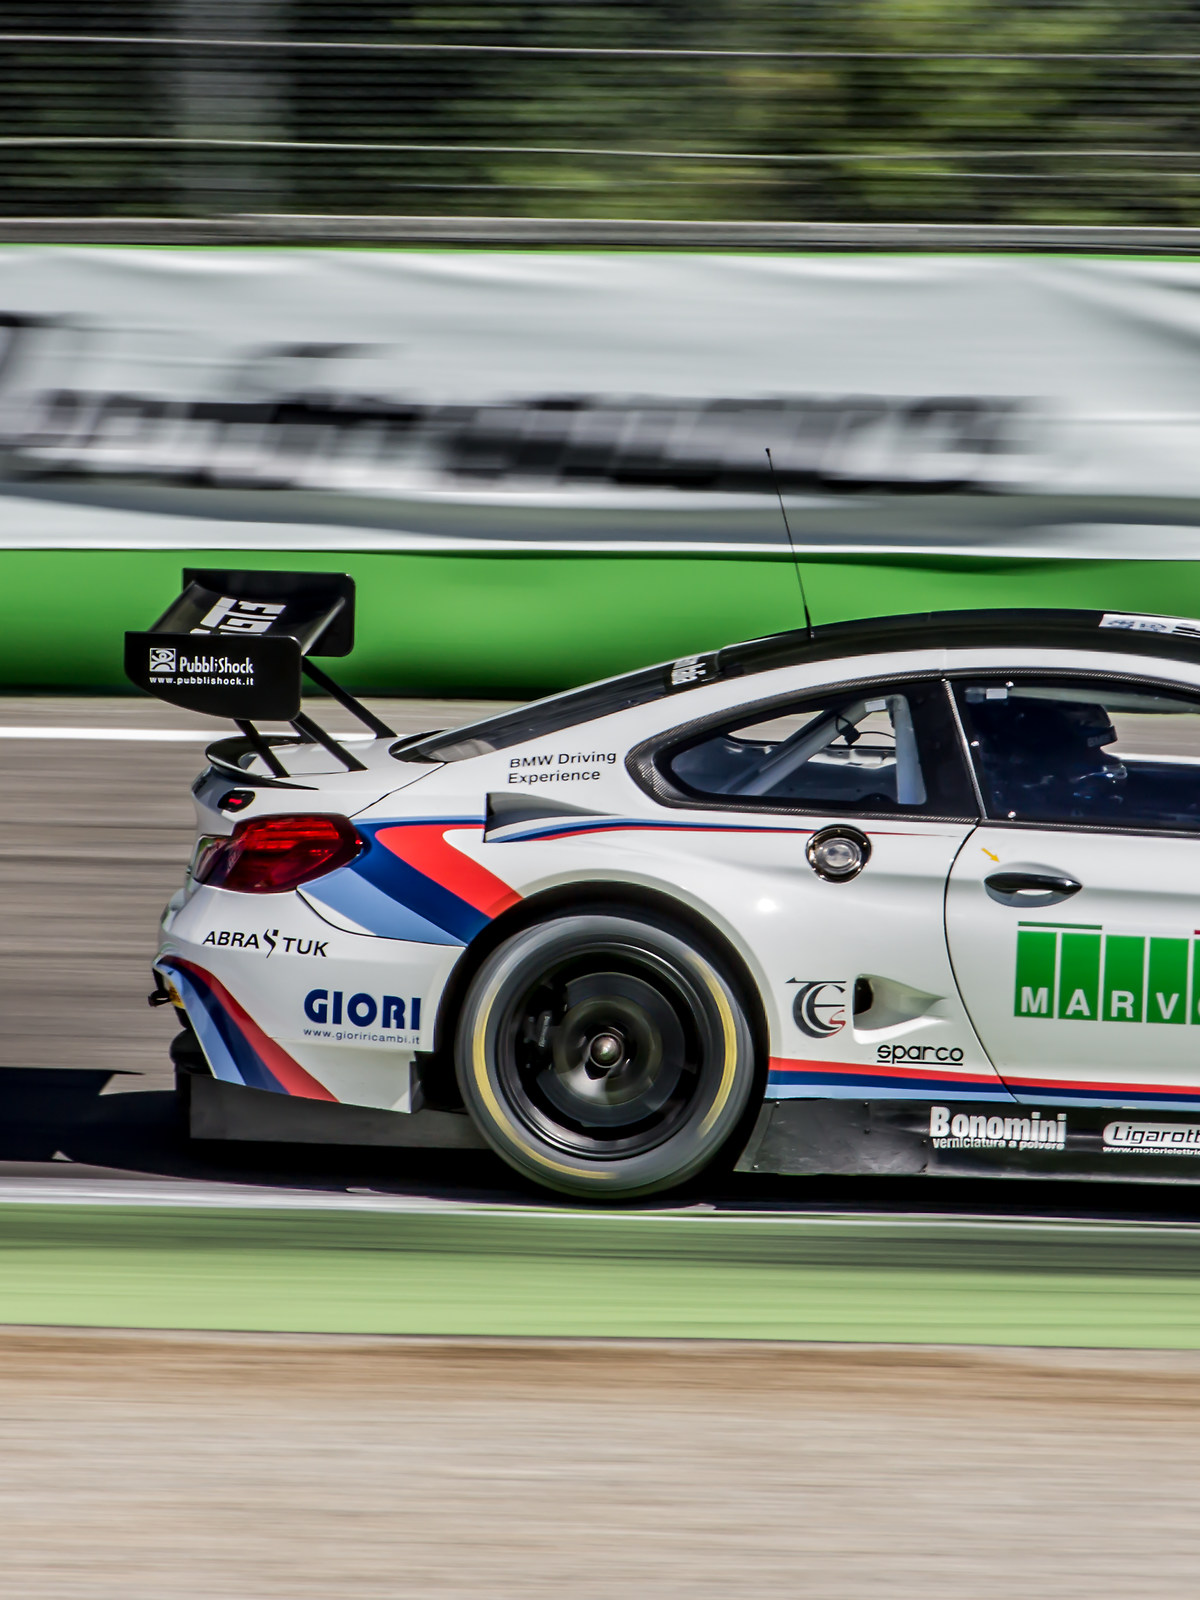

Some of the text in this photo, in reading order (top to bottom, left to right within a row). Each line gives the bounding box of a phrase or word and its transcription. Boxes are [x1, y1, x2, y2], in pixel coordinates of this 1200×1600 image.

[179, 656, 254, 674] PubbliShock
[149, 676, 255, 686] www.pubblishock.it
[509, 750, 617, 769] BMW Driving
[508, 770, 601, 785] Experience
[303, 988, 422, 1031] GIORI
[303, 1028, 420, 1045] www.gioriricambi.it
[876, 1044, 964, 1064] sparco
[929, 1106, 1067, 1143] Bonomini
[932, 1136, 1066, 1151] verniciatura a polvere
